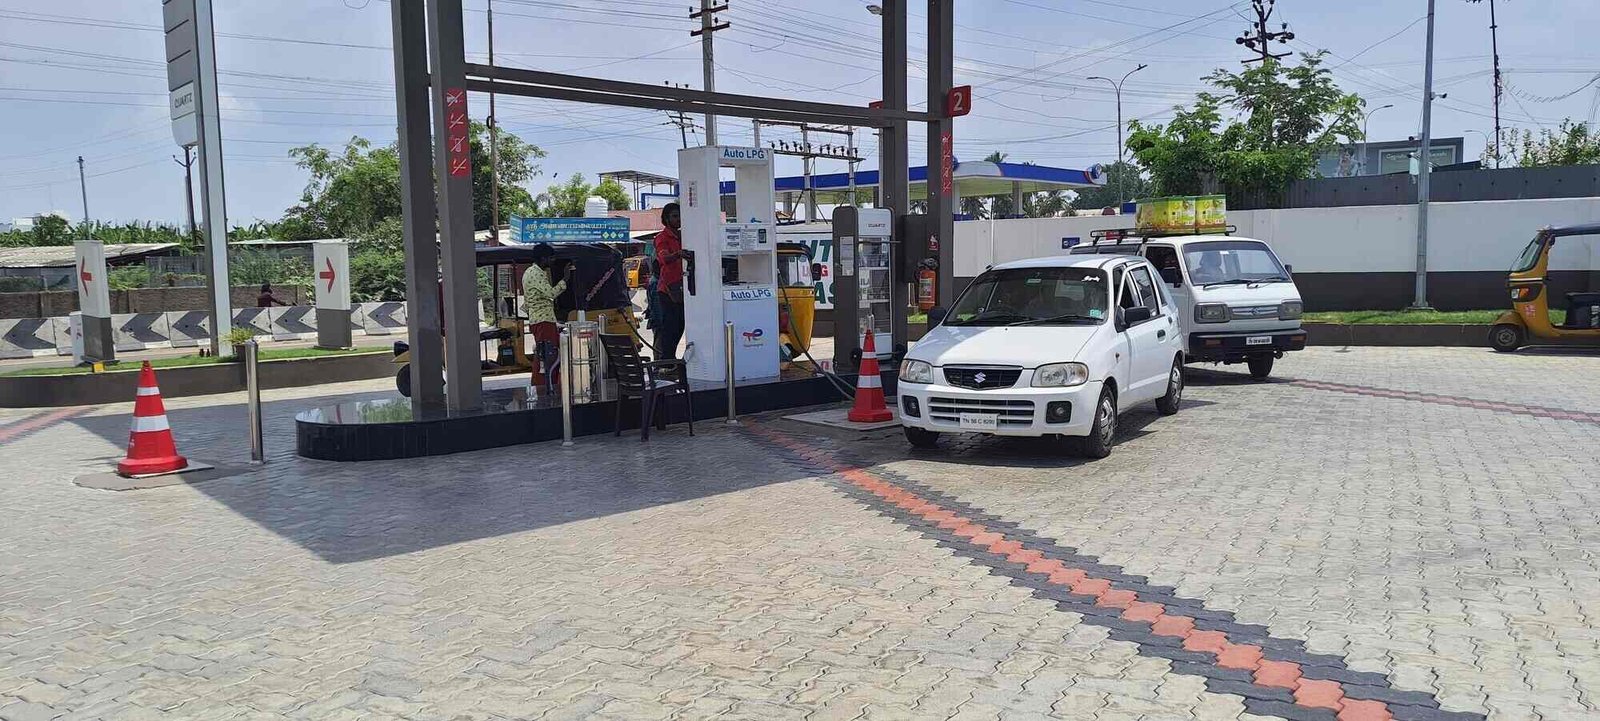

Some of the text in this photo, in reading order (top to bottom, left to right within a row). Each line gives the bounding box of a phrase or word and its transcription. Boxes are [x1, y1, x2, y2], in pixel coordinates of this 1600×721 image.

[174, 92, 193, 108] QUARTZ
[953, 91, 963, 112] 2
[724, 149, 764, 158] Auto LPG
[731, 289, 772, 299] Auto LPG
